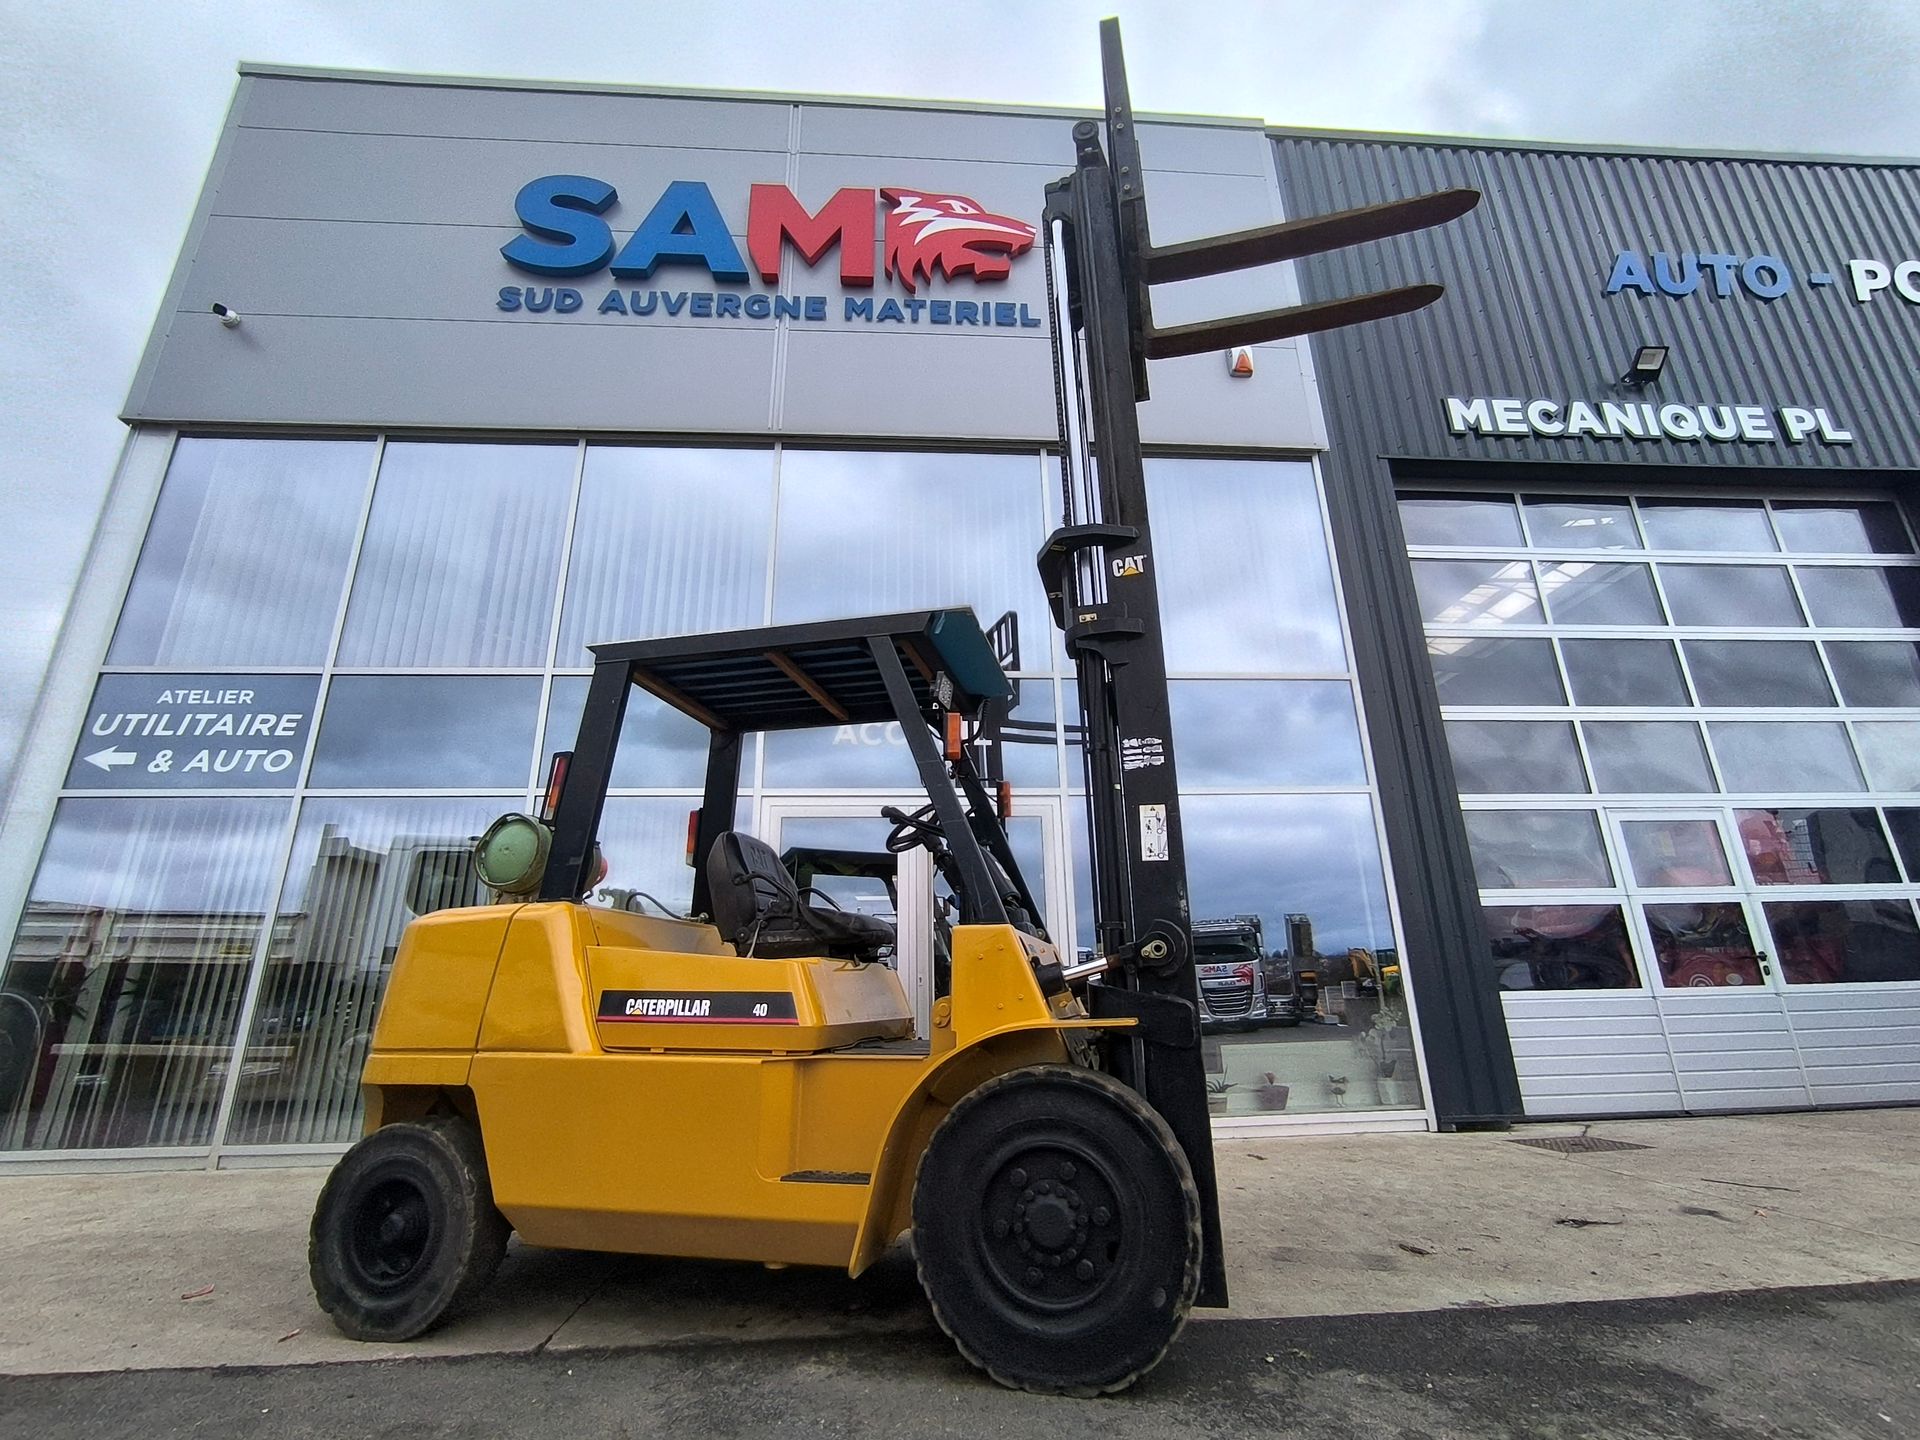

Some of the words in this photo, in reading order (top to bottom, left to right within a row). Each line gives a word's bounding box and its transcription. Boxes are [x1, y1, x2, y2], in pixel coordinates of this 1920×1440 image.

[500, 174, 875, 286] SAM
[1606, 250, 1793, 298] AUTO
[497, 286, 583, 314] SUD
[598, 289, 827, 321] AUVERGNE
[844, 297, 1042, 327] MATERIEL
[1446, 397, 1776, 441] MECANIQUE
[1779, 407, 1853, 443] PL
[1112, 554, 1145, 577] CAT
[156, 690, 255, 704] ATELIER
[92, 713, 303, 736] UTILITAIRE
[147, 749, 174, 773] &
[181, 749, 294, 773] AUTO
[625, 998, 711, 1017] CATERPILLAR
[752, 1003, 768, 1017] 40
